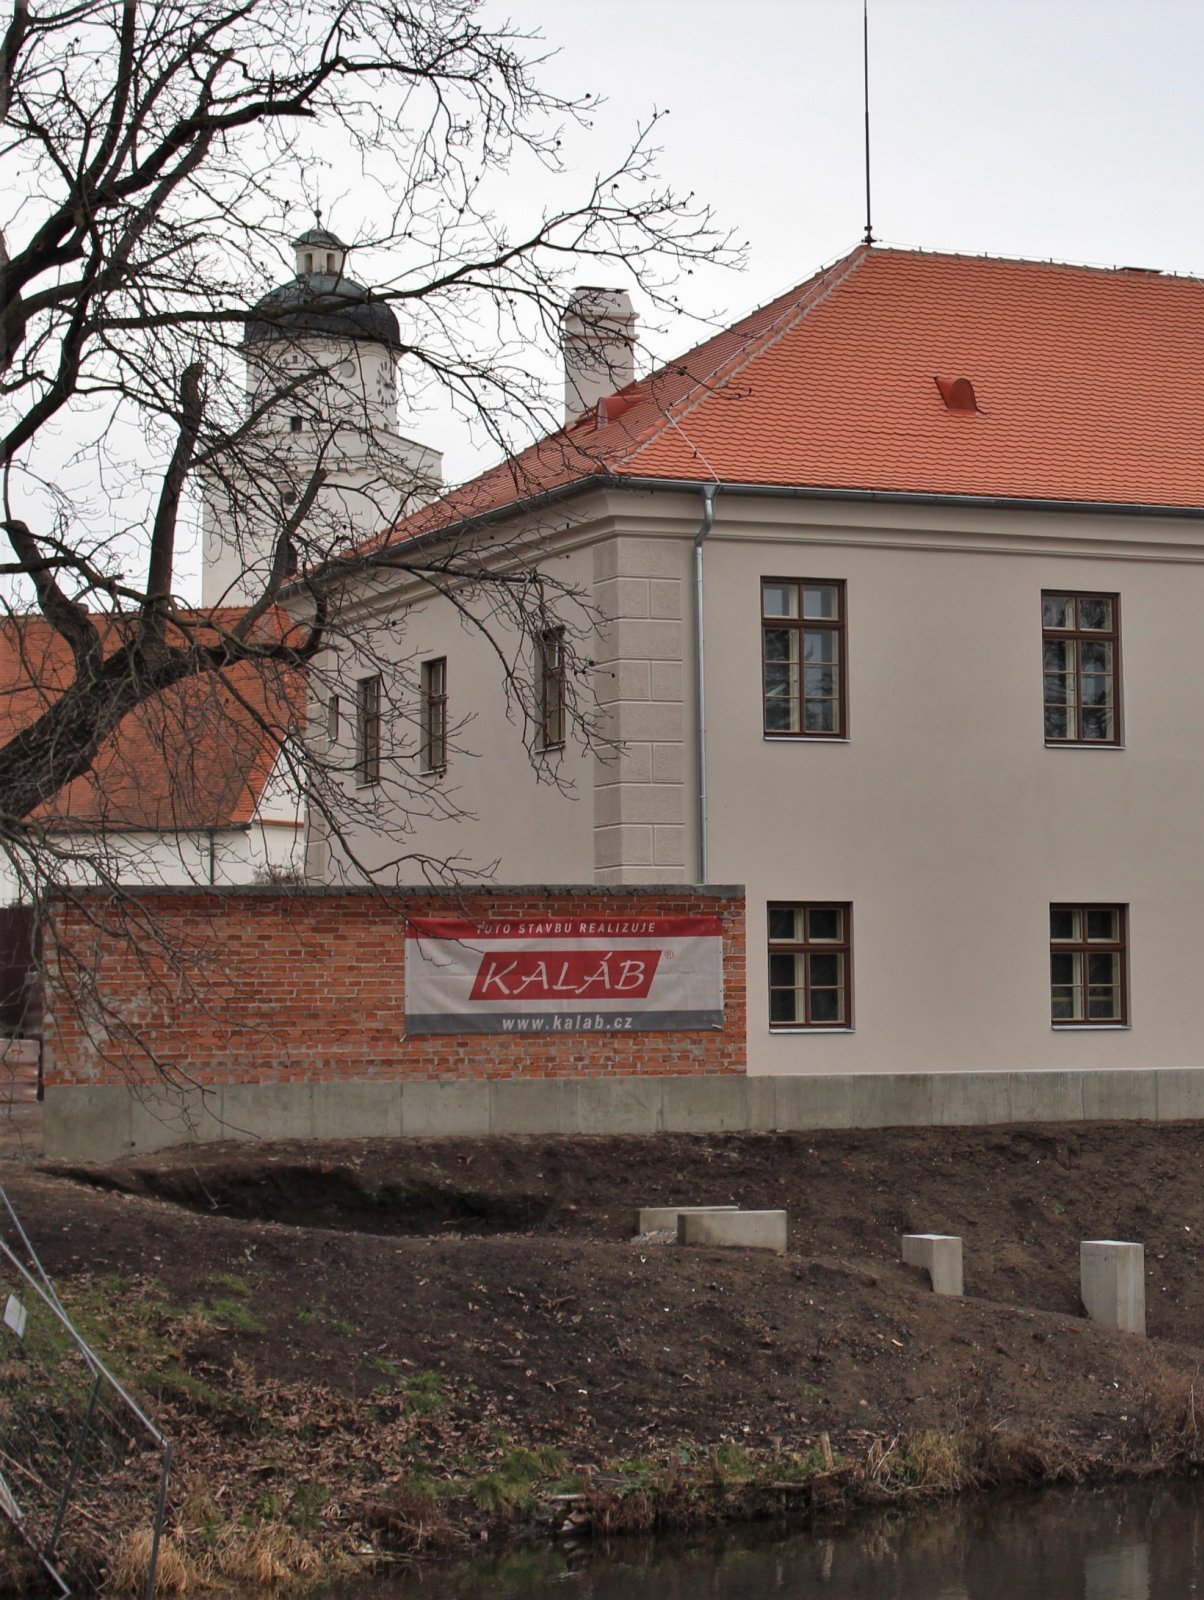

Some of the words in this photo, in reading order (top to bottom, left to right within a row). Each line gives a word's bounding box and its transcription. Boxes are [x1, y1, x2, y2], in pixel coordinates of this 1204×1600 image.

[518, 923, 572, 934] STAVBU
[579, 922, 656, 933] REALIZUJE
[481, 951, 646, 995] KALÁB
[502, 1014, 633, 1031] www.kalab.cz
